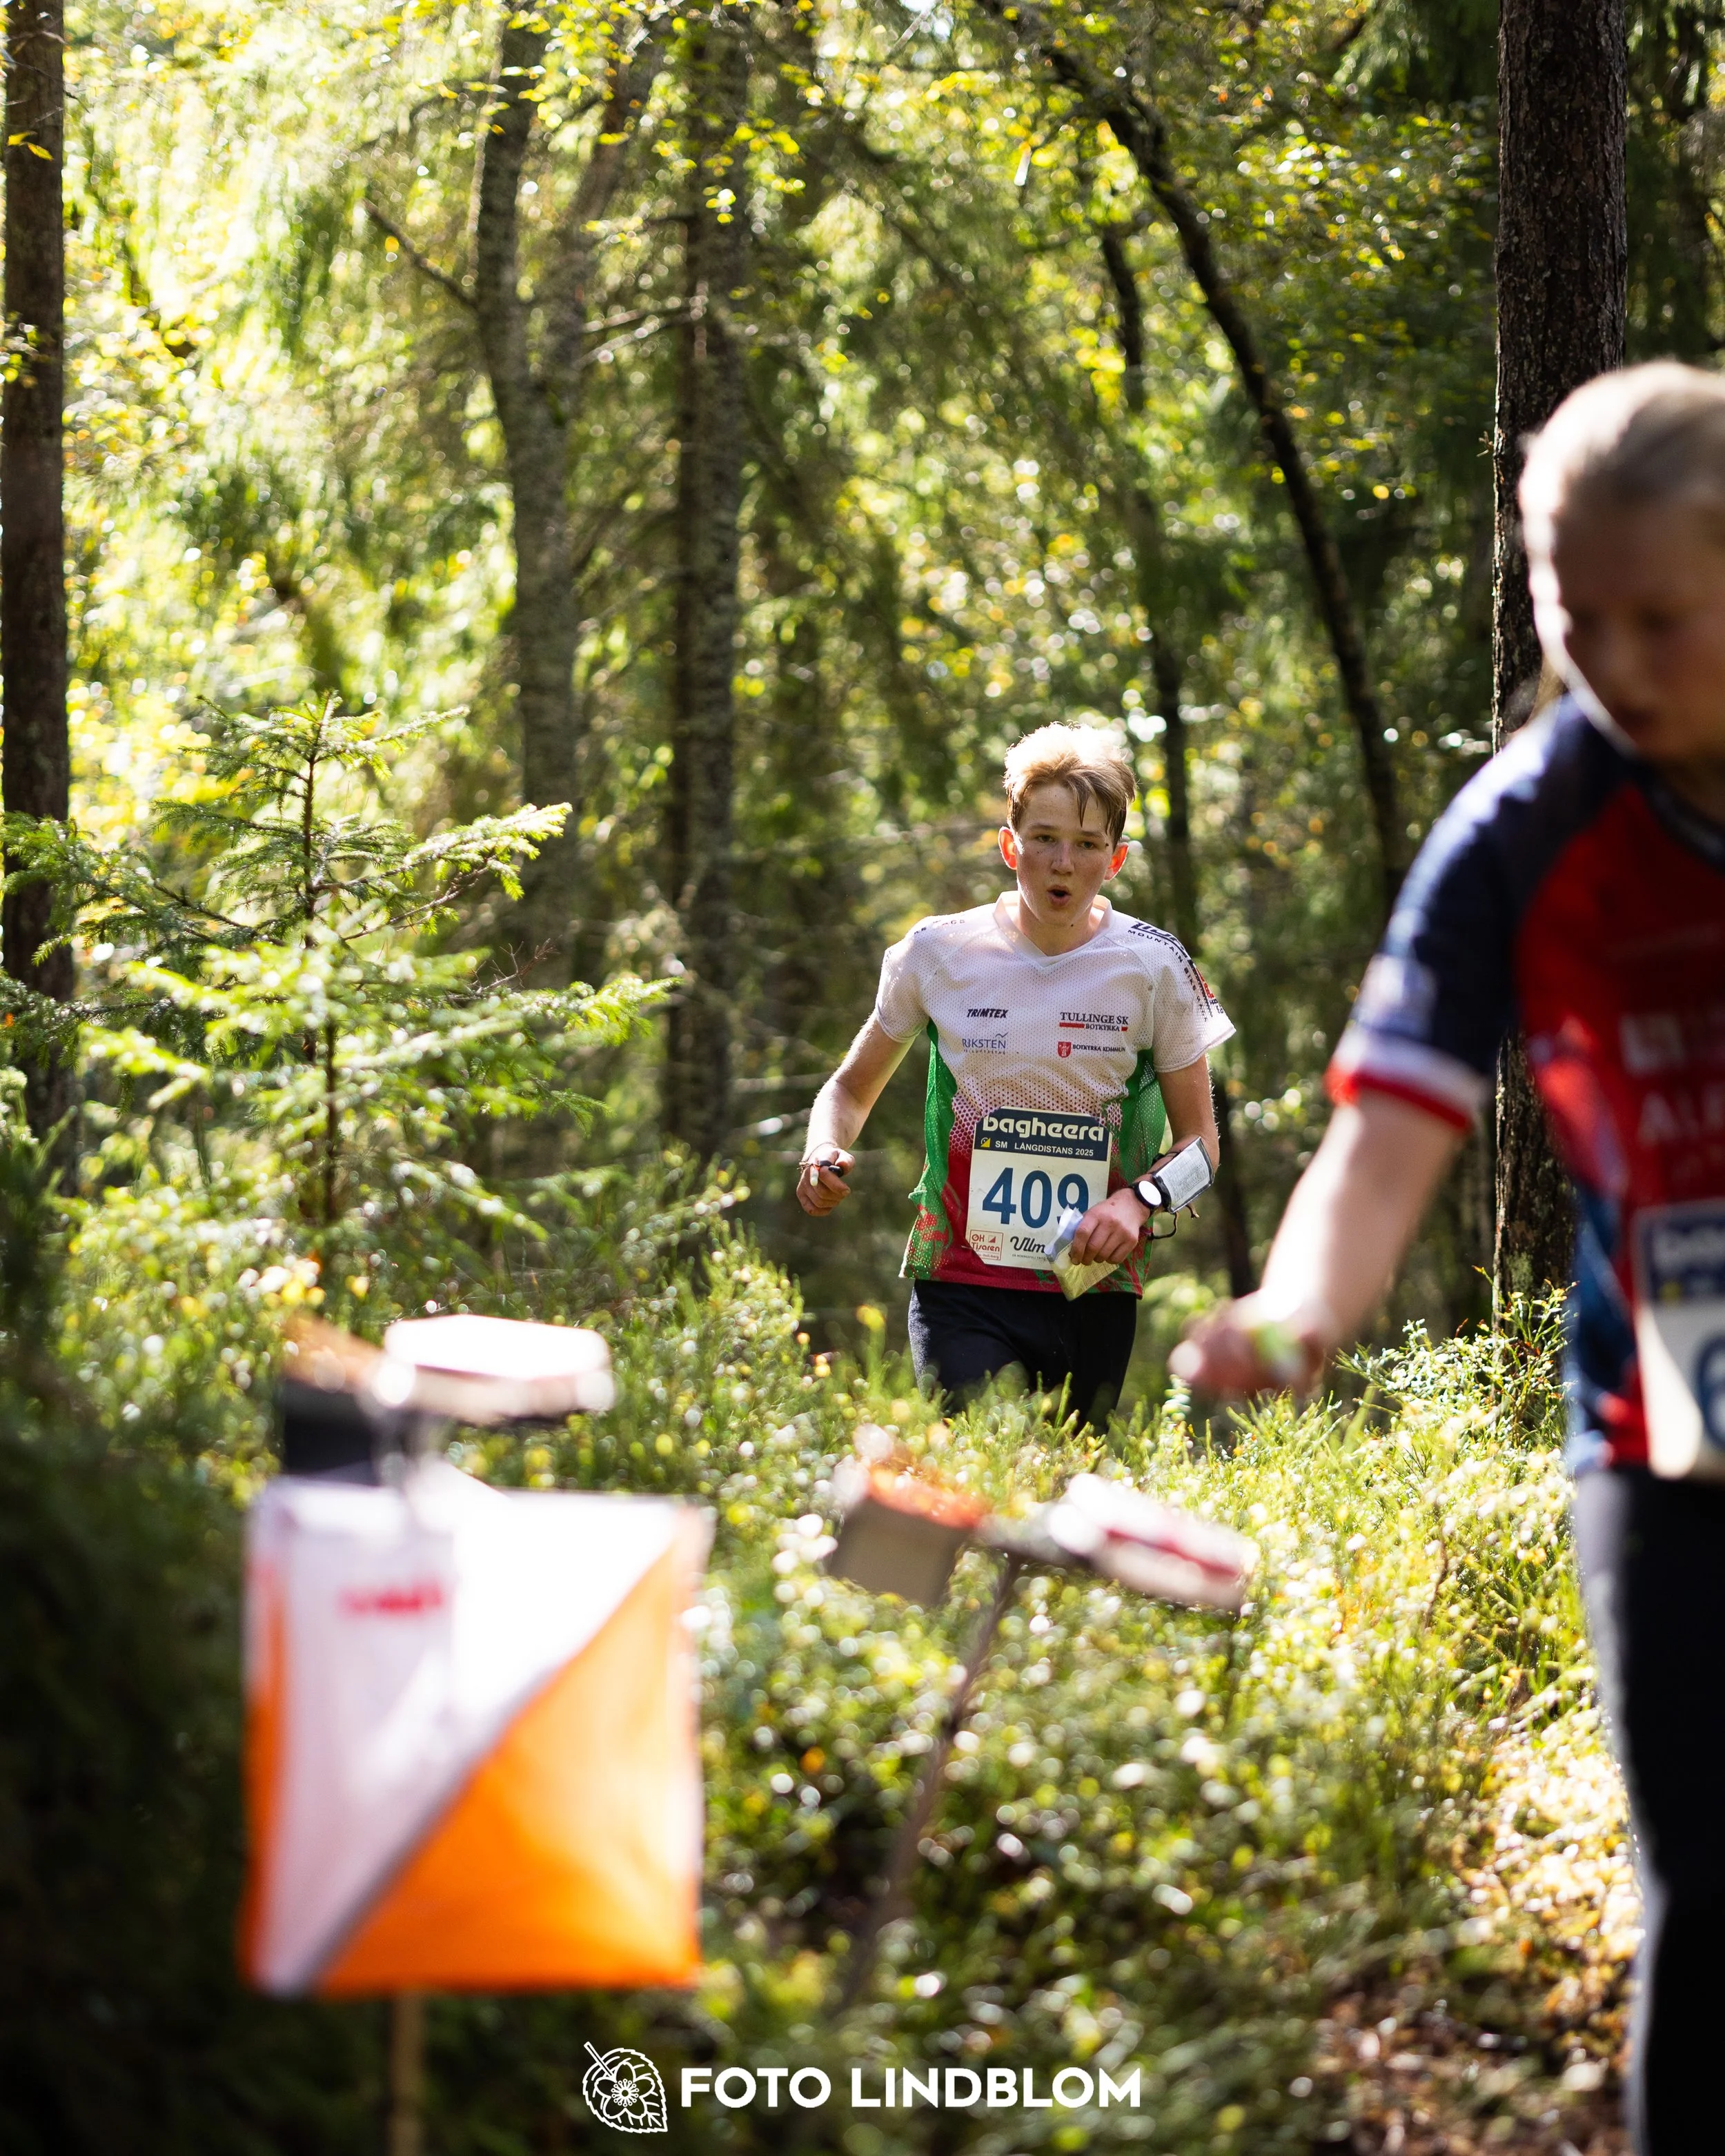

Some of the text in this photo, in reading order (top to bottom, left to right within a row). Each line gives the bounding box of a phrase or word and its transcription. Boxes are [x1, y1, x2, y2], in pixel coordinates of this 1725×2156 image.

[1127, 930, 1183, 962] MOUNTAIN
[966, 1008, 1009, 1018] TRIMTEX
[1060, 1011, 1129, 1025] TULLINGE SK
[1085, 1023, 1120, 1032] BOTKYRKA
[962, 1038, 1006, 1049] RIKSTEN
[1072, 1044, 1102, 1052] BOTKYRKA
[983, 1116, 1103, 1142] bagheera
[995, 1140, 1008, 1149] SM
[1075, 1148, 1094, 1156] 2025
[982, 1167, 1089, 1229] 409
[972, 1242, 1000, 1252] Tisaren
[1010, 1236, 1045, 1253] Ullm
